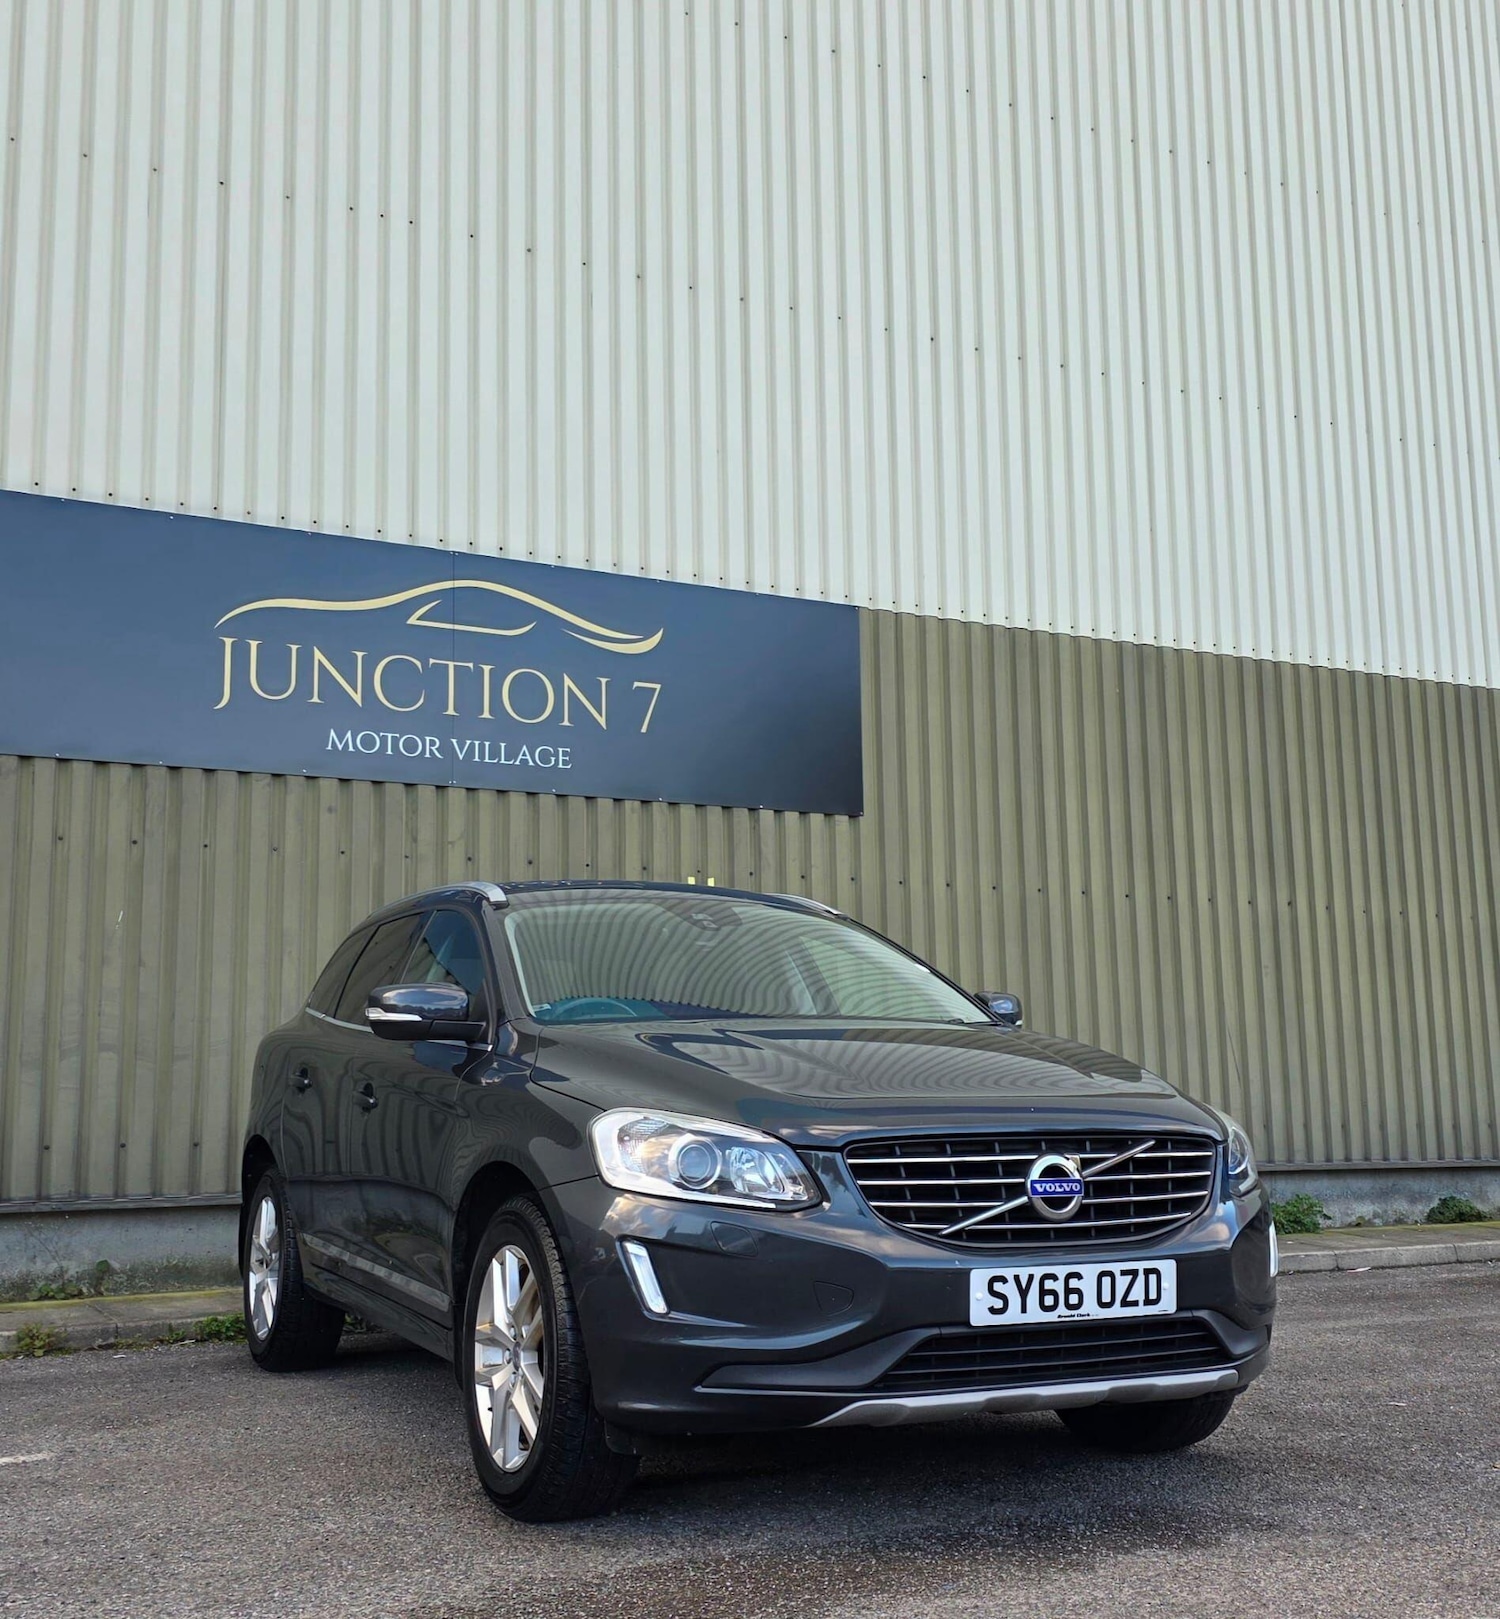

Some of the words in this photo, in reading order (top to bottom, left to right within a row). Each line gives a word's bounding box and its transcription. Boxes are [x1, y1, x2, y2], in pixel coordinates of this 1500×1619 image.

[213, 636, 610, 730] JUNCTION
[632, 681, 662, 733] 7
[325, 728, 443, 760] MOTOR
[450, 738, 572, 769] VILLAGE
[1033, 1182, 1081, 1193] VOLVO
[987, 1271, 1084, 1315] SY66
[1096, 1267, 1162, 1309] OZD
